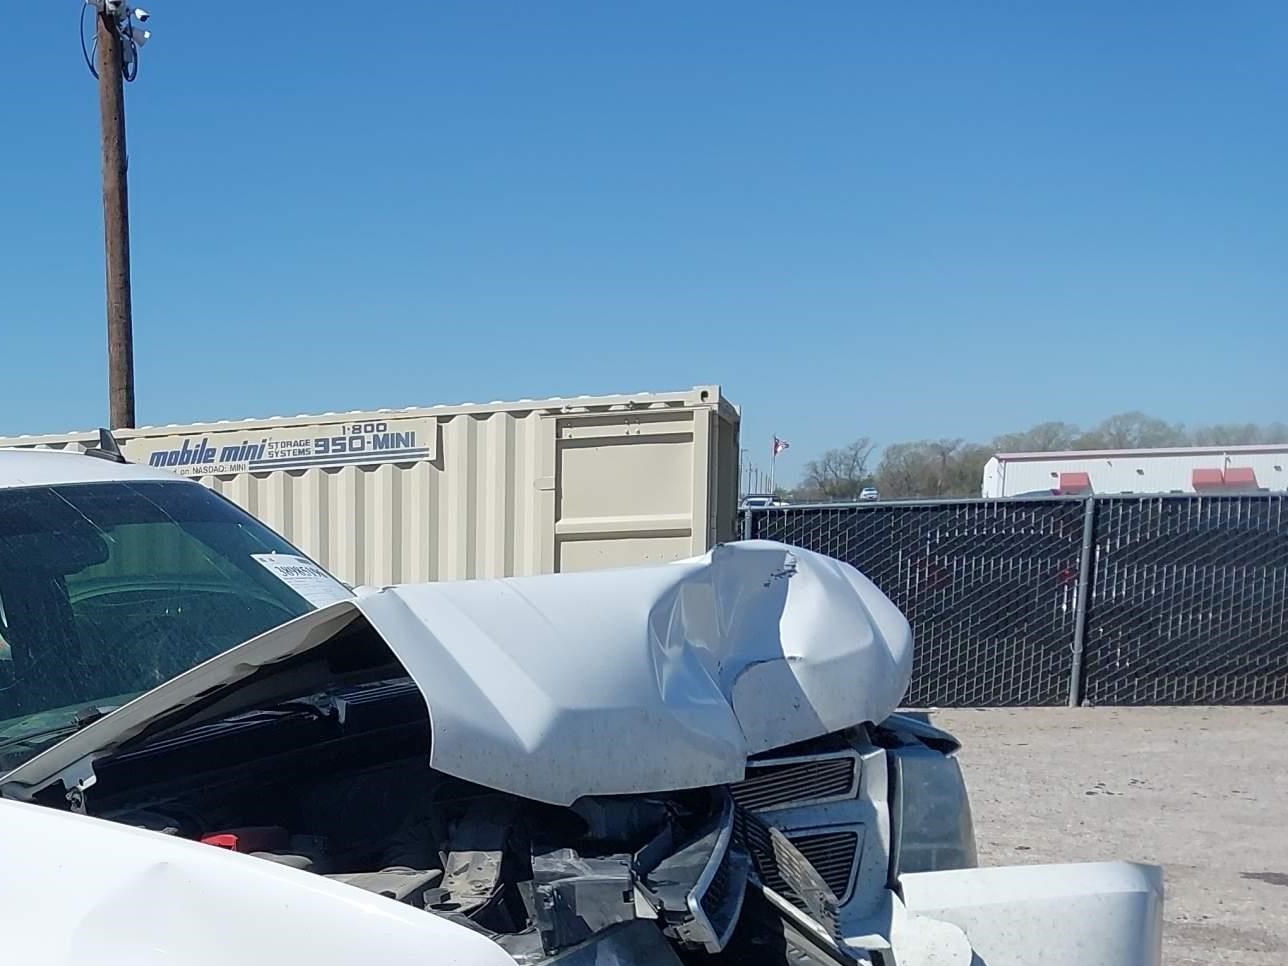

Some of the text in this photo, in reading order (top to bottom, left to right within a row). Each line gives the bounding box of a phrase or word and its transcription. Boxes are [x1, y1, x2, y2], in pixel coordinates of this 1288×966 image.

[268, 439, 311, 450] STORAGE
[314, 431, 416, 455] 950-MINI
[149, 437, 267, 467] mobile mini
[268, 447, 312, 459] SYSTEMS
[229, 463, 247, 473] MINI
